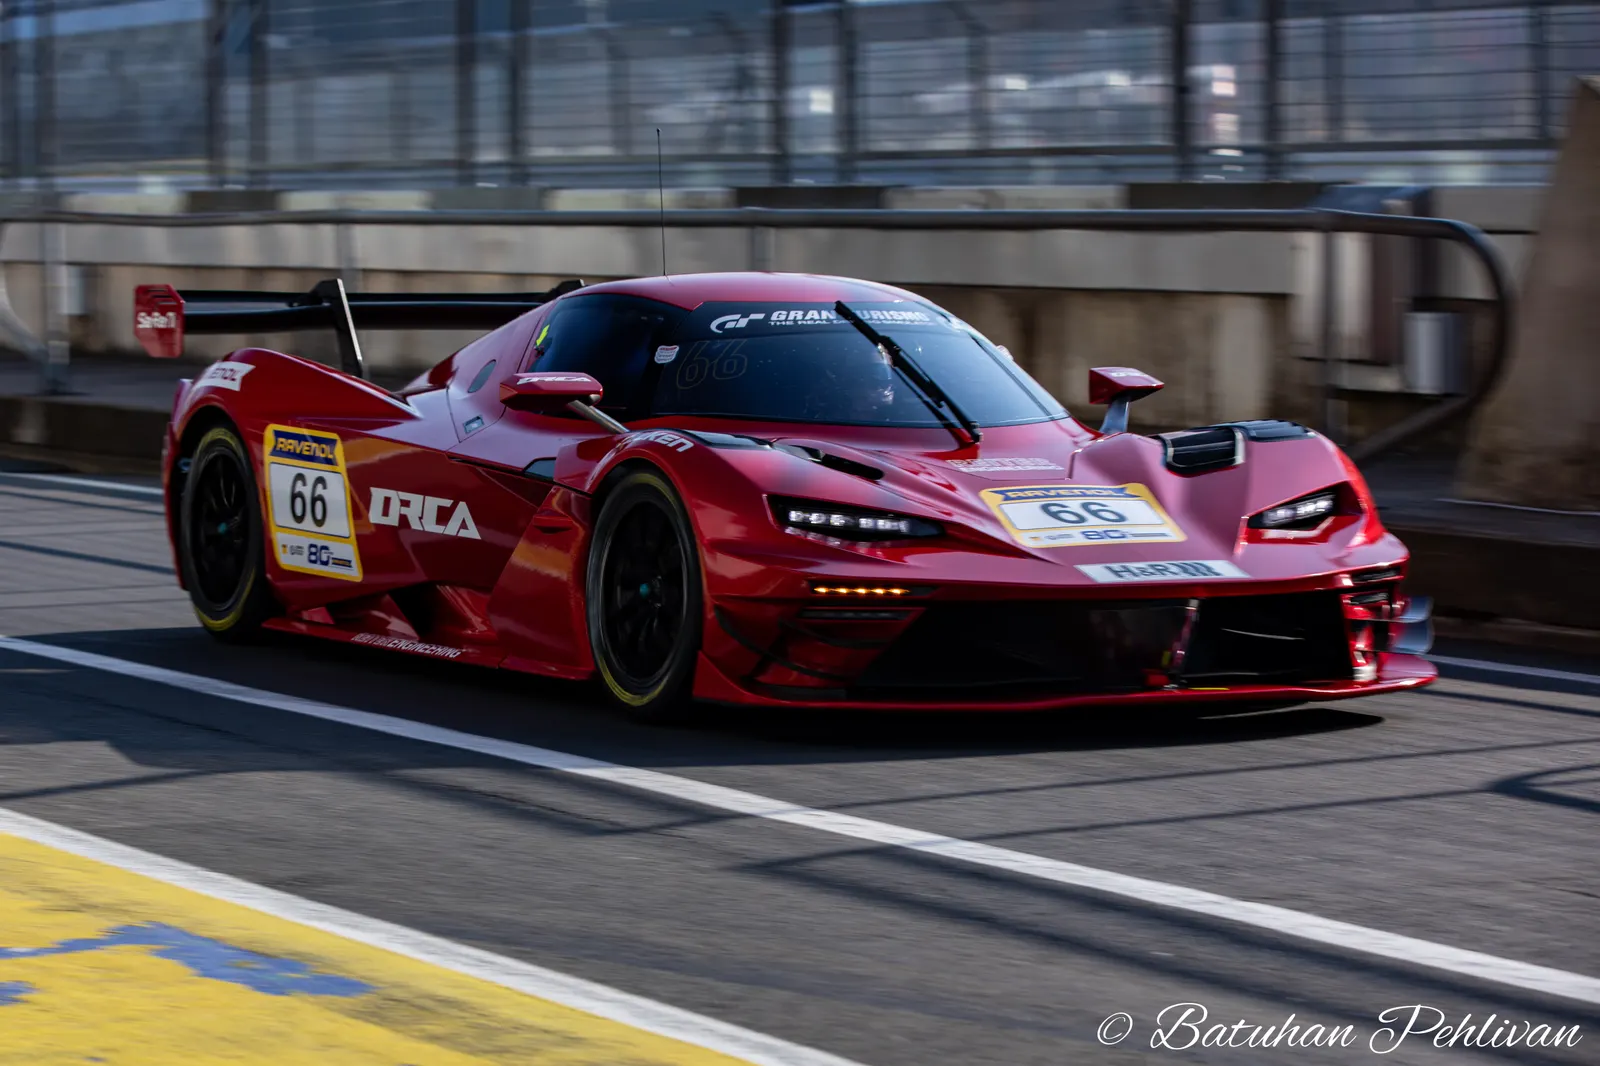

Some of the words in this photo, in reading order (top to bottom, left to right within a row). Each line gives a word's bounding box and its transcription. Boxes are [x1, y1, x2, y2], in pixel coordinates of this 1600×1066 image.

[770, 309, 837, 321] GRAN
[857, 309, 931, 322] URISMO
[676, 338, 748, 390] 66
[275, 437, 334, 459] RAVENOL
[290, 472, 328, 528] 66
[1004, 488, 1126, 498] RAVENOL
[368, 486, 482, 540] ORCA
[1040, 501, 1128, 525] 66
